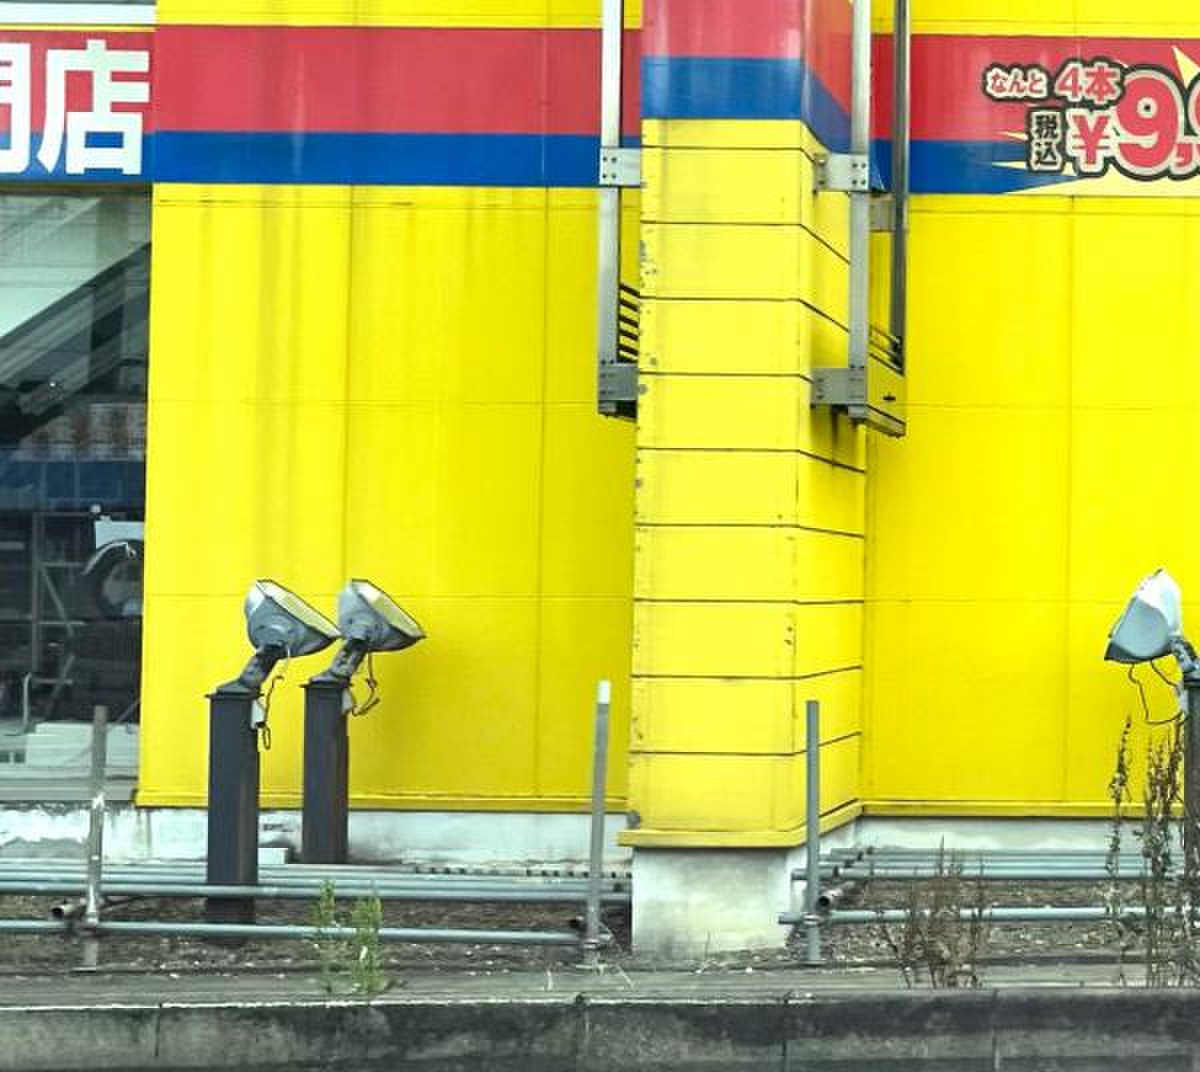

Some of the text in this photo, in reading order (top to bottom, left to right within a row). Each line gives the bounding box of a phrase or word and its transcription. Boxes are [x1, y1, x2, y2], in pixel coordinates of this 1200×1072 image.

[985, 62, 1121, 105] なんと 4本
